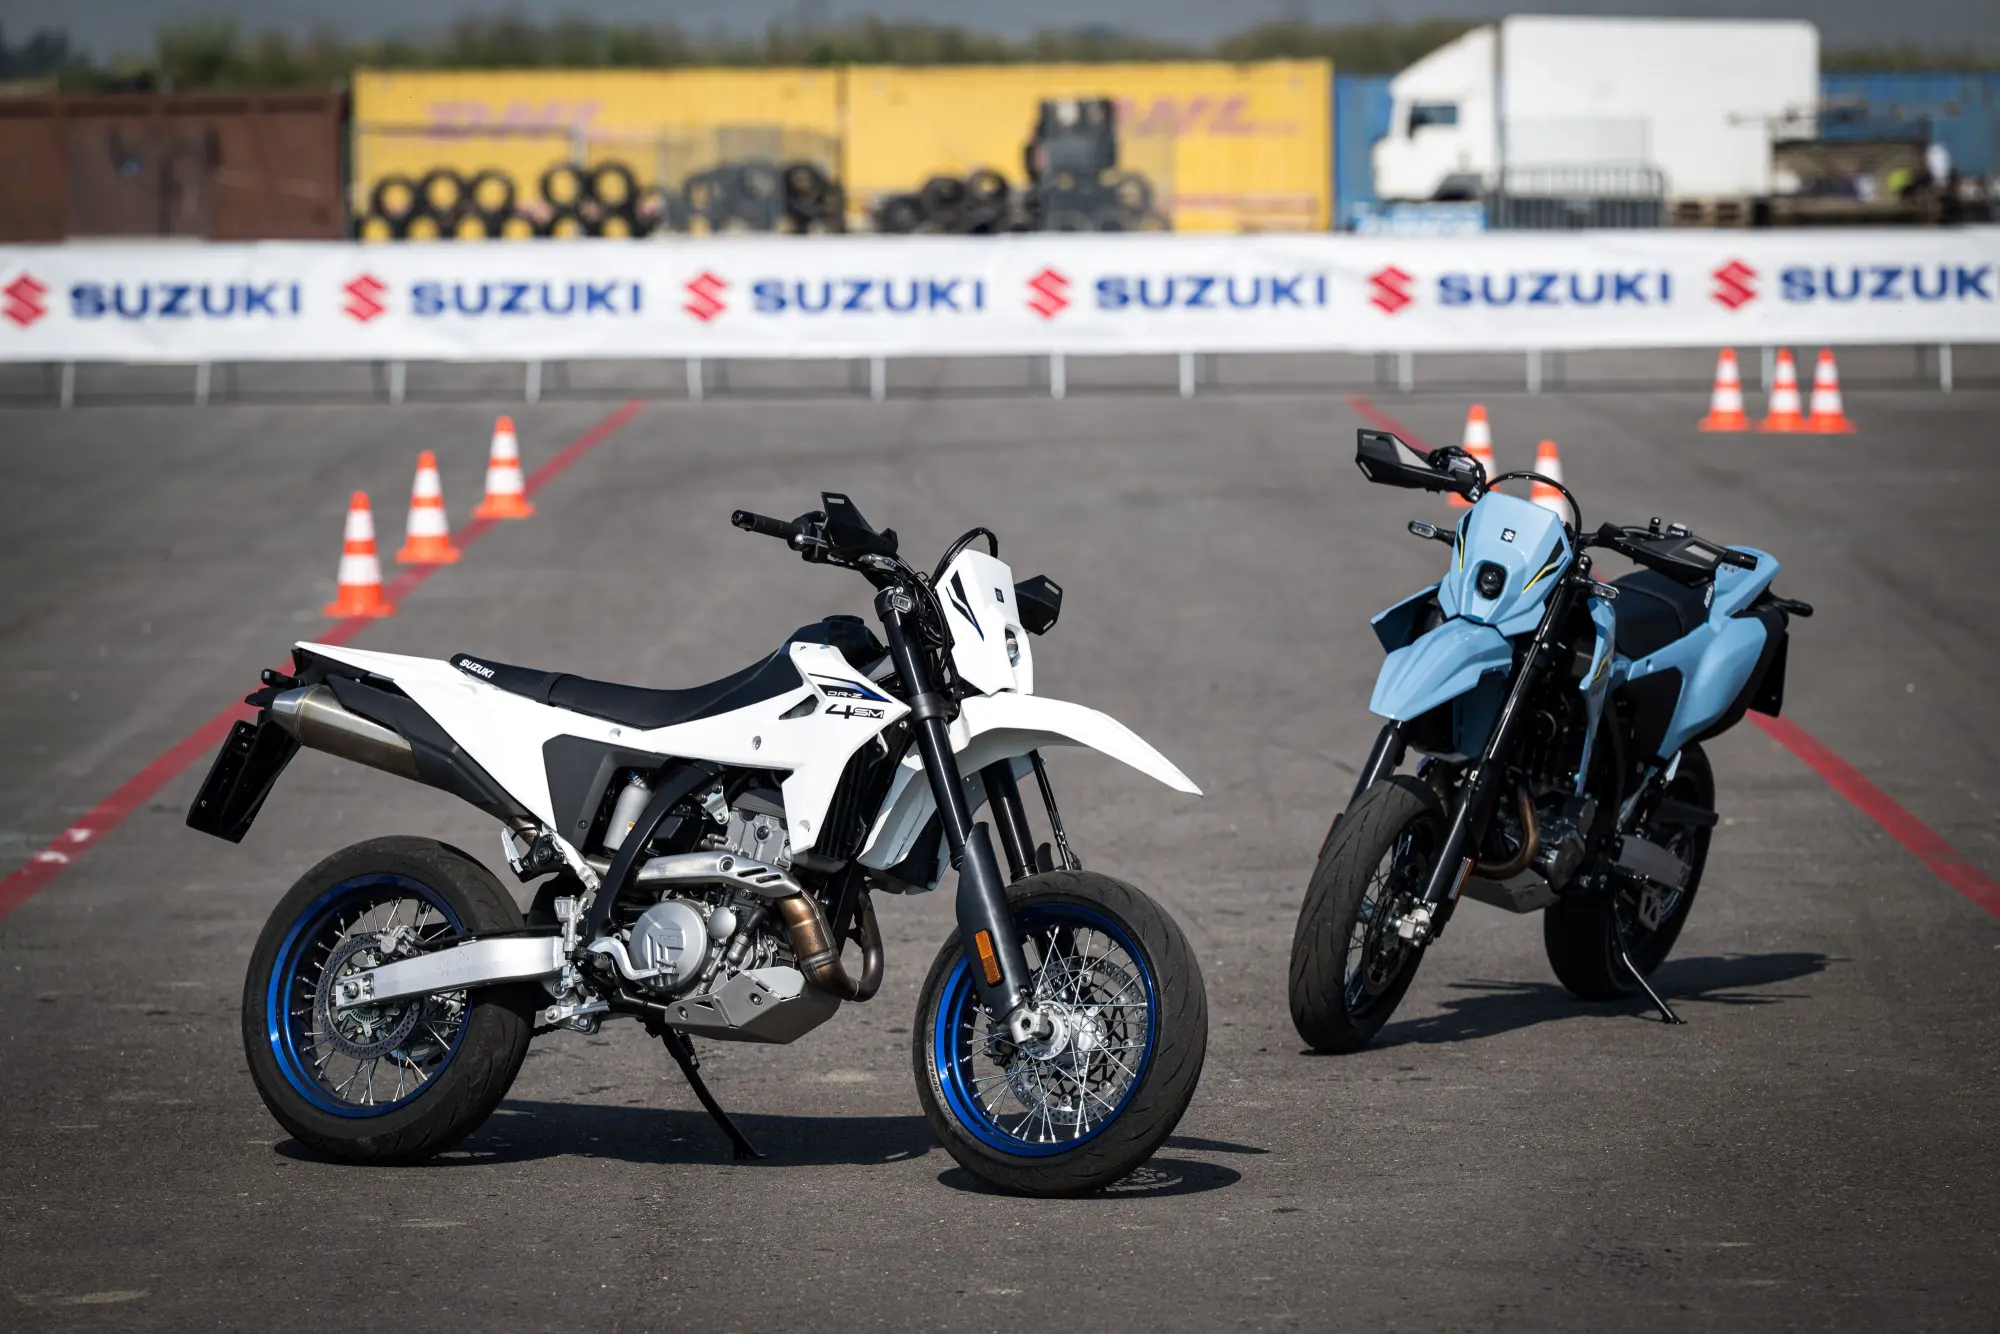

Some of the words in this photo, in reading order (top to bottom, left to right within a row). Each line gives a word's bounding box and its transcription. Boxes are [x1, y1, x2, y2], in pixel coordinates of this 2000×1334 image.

[409, 281, 643, 317] SUZUKI
[751, 279, 985, 314] SUZUKI
[1094, 274, 1328, 309] SUZUKI
[1436, 271, 1672, 307] SUZUKI
[1779, 262, 2000, 301] SUZUK
[70, 281, 300, 318] SUZUKI
[460, 658, 495, 678] SUZUKI
[827, 690, 863, 698] DR-Z
